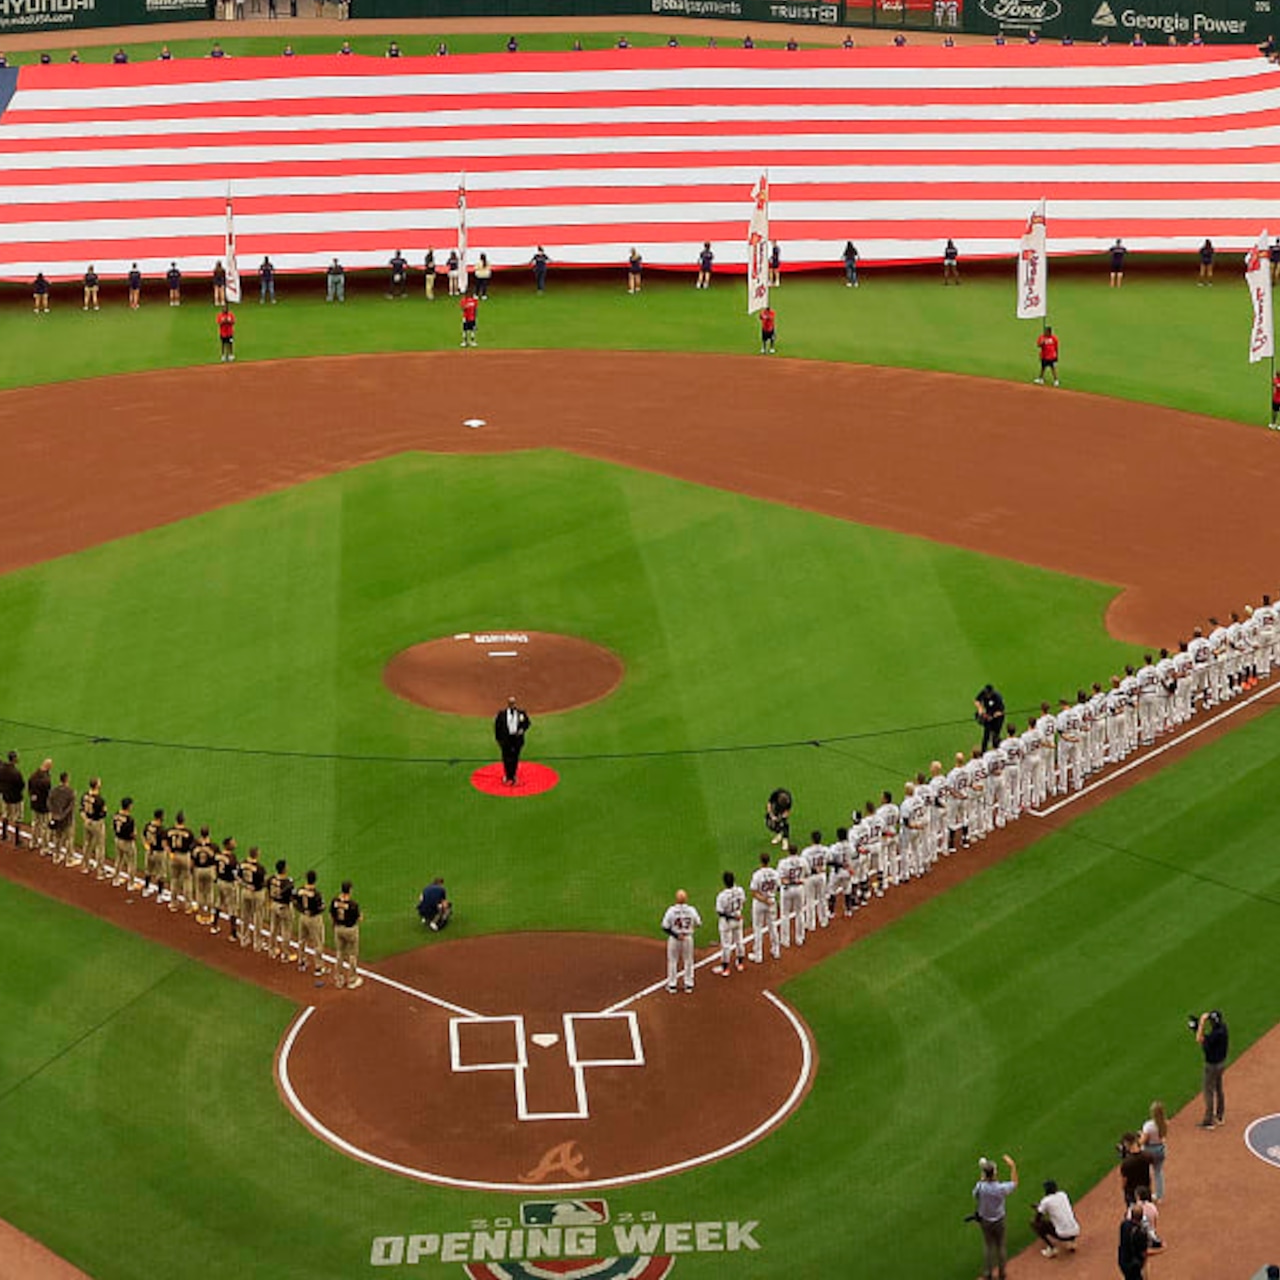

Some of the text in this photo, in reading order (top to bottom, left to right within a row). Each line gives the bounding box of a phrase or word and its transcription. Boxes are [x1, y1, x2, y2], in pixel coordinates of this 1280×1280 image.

[771, 4, 819, 19] TRUIST
[1121, 8, 1247, 36] Georgia Power
[370, 1221, 762, 1267] OPENING WEEK
